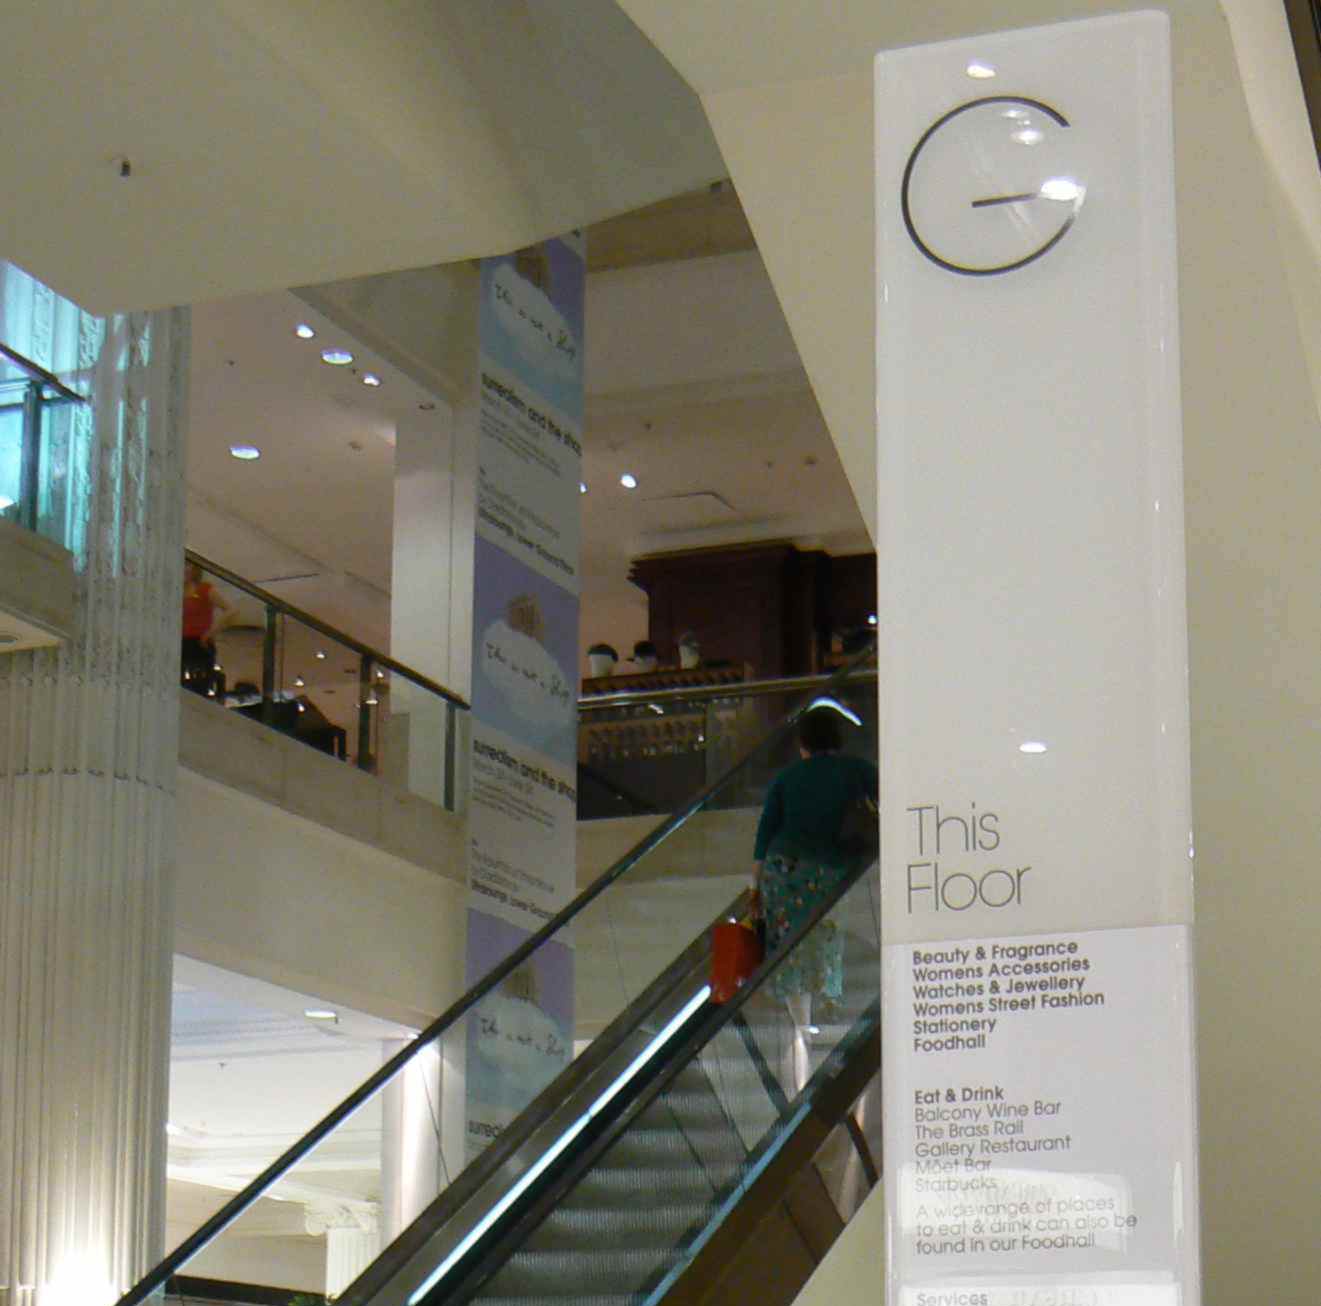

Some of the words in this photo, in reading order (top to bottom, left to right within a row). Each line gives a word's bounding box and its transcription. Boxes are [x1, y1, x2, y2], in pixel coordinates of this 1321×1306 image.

[906, 802, 1000, 855] This
[907, 862, 1032, 914] Floor
[912, 947, 970, 966] Beauty
[975, 945, 987, 960] &
[991, 941, 1078, 961] Fragrance
[912, 965, 984, 983] Womens
[988, 958, 1090, 977] Accessories
[912, 982, 984, 1000] Watches
[988, 979, 1001, 994] &
[1005, 975, 1086, 996] Jewellery
[912, 999, 984, 1018] Womens
[988, 995, 1036, 1013] Street
[1040, 990, 1105, 1009] Fashion
[912, 1017, 997, 1036] Stationery
[913, 1034, 986, 1053] Foodhall
[914, 1089, 941, 1105] Eat
[945, 1088, 957, 1103] &
[961, 1085, 1005, 1102] Drink
[914, 1105, 982, 1123] Balcony
[986, 1102, 1029, 1119] Wine
[1034, 1100, 1061, 1116] Bar
[914, 1124, 944, 1140] The
[949, 1121, 990, 1139] Brass
[993, 1119, 1024, 1136] Rail
[914, 1140, 975, 1159] Gallery
[980, 1135, 1072, 1155] Restaurant
[965, 1157, 992, 1173] Bar
[914, 1174, 998, 1193] Starbucks
[916, 1205, 928, 1219] A
[978, 1200, 1031, 1220] range
[1035, 1197, 1053, 1214] of
[1057, 1195, 1115, 1214] places
[916, 1222, 934, 1238] to
[939, 1219, 968, 1236] eat
[972, 1219, 985, 1235] &
[990, 1216, 1033, 1234] drink
[1036, 1216, 1070, 1232] can
[1075, 1212, 1109, 1230] also
[1113, 1210, 1138, 1228] be
[916, 1238, 966, 1255] found
[970, 1236, 986, 1253] in
[990, 1237, 1018, 1252] our
[1022, 1232, 1096, 1251] Foodhall
